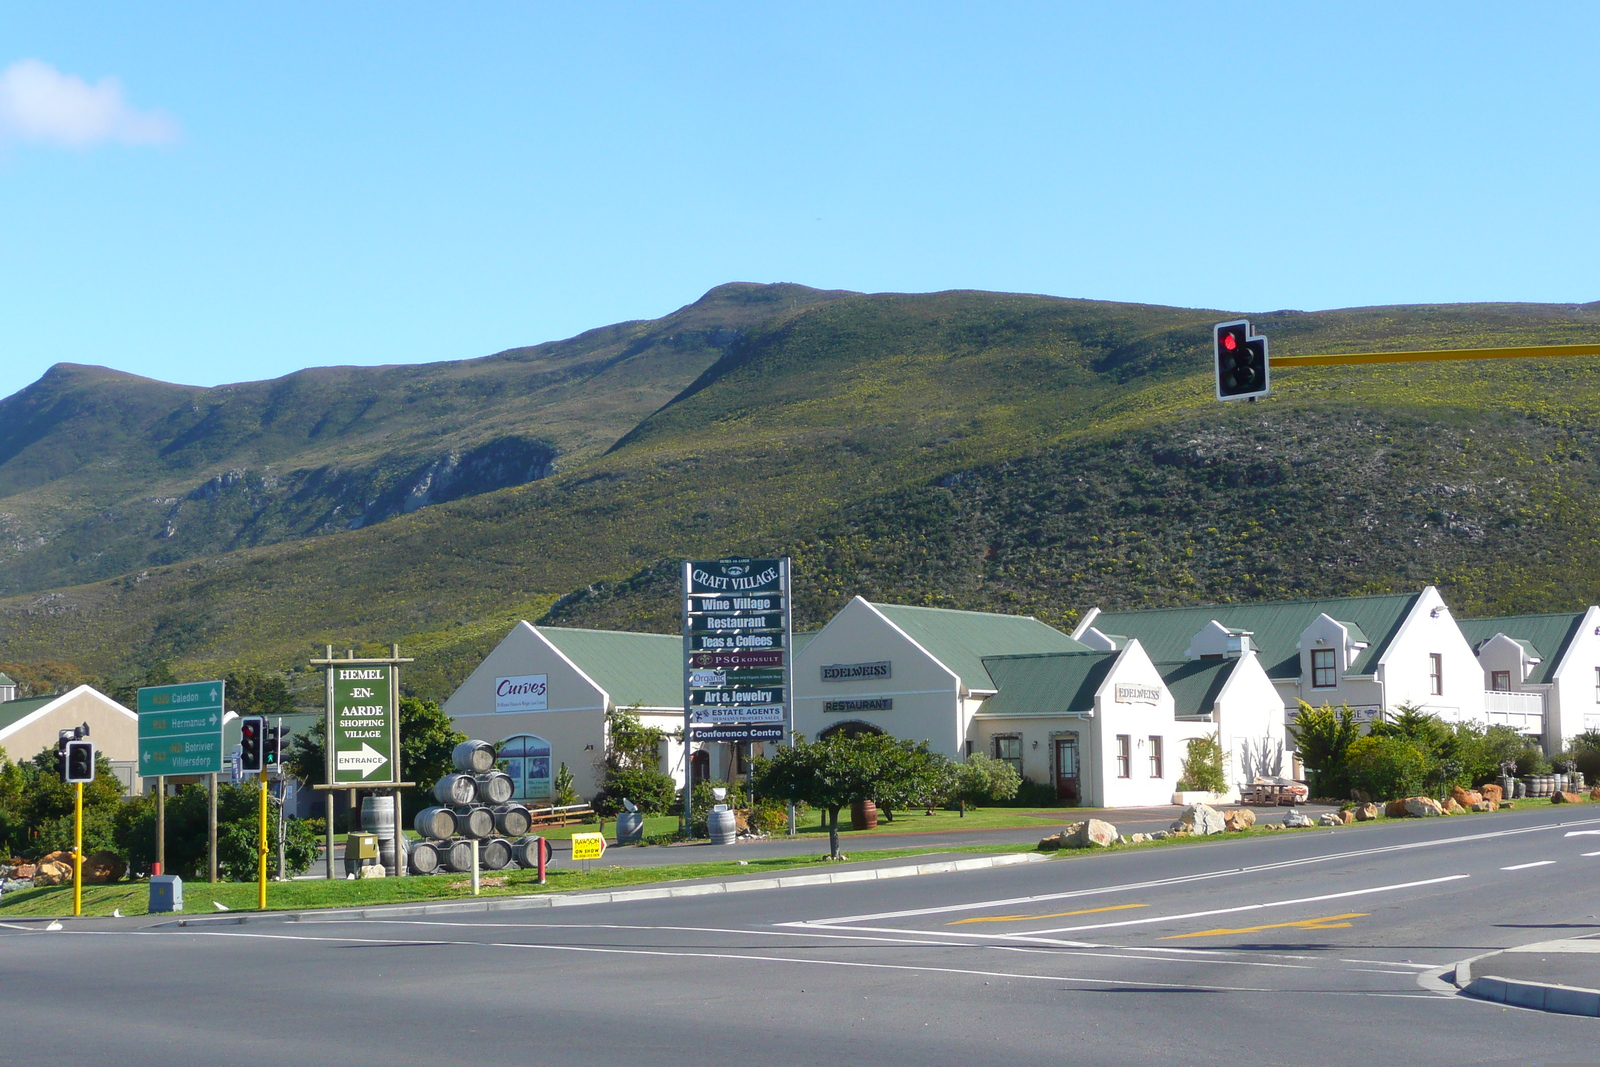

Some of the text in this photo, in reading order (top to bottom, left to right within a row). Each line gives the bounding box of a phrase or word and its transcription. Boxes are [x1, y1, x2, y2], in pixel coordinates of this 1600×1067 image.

[692, 567, 778, 590] CRAFT VILLAGE
[702, 598, 770, 610] Wine Village
[708, 616, 766, 628] Restaurant
[702, 635, 772, 647] Teas & Coffees
[339, 670, 384, 680] HEMEL
[824, 665, 887, 678] EDELWEISS
[694, 674, 725, 684] Organic
[350, 688, 374, 698] -EN-
[497, 679, 546, 697] Curves
[172, 692, 199, 703] Caledon
[705, 690, 772, 702] Art & Jewelry
[1119, 688, 1160, 700] EDELWEISS
[825, 700, 888, 710] RESTAURANT
[341, 706, 384, 716] AARDE
[172, 718, 206, 728] Hermanus
[185, 741, 214, 752] Botrivier
[172, 756, 211, 767] Villiersdorp
